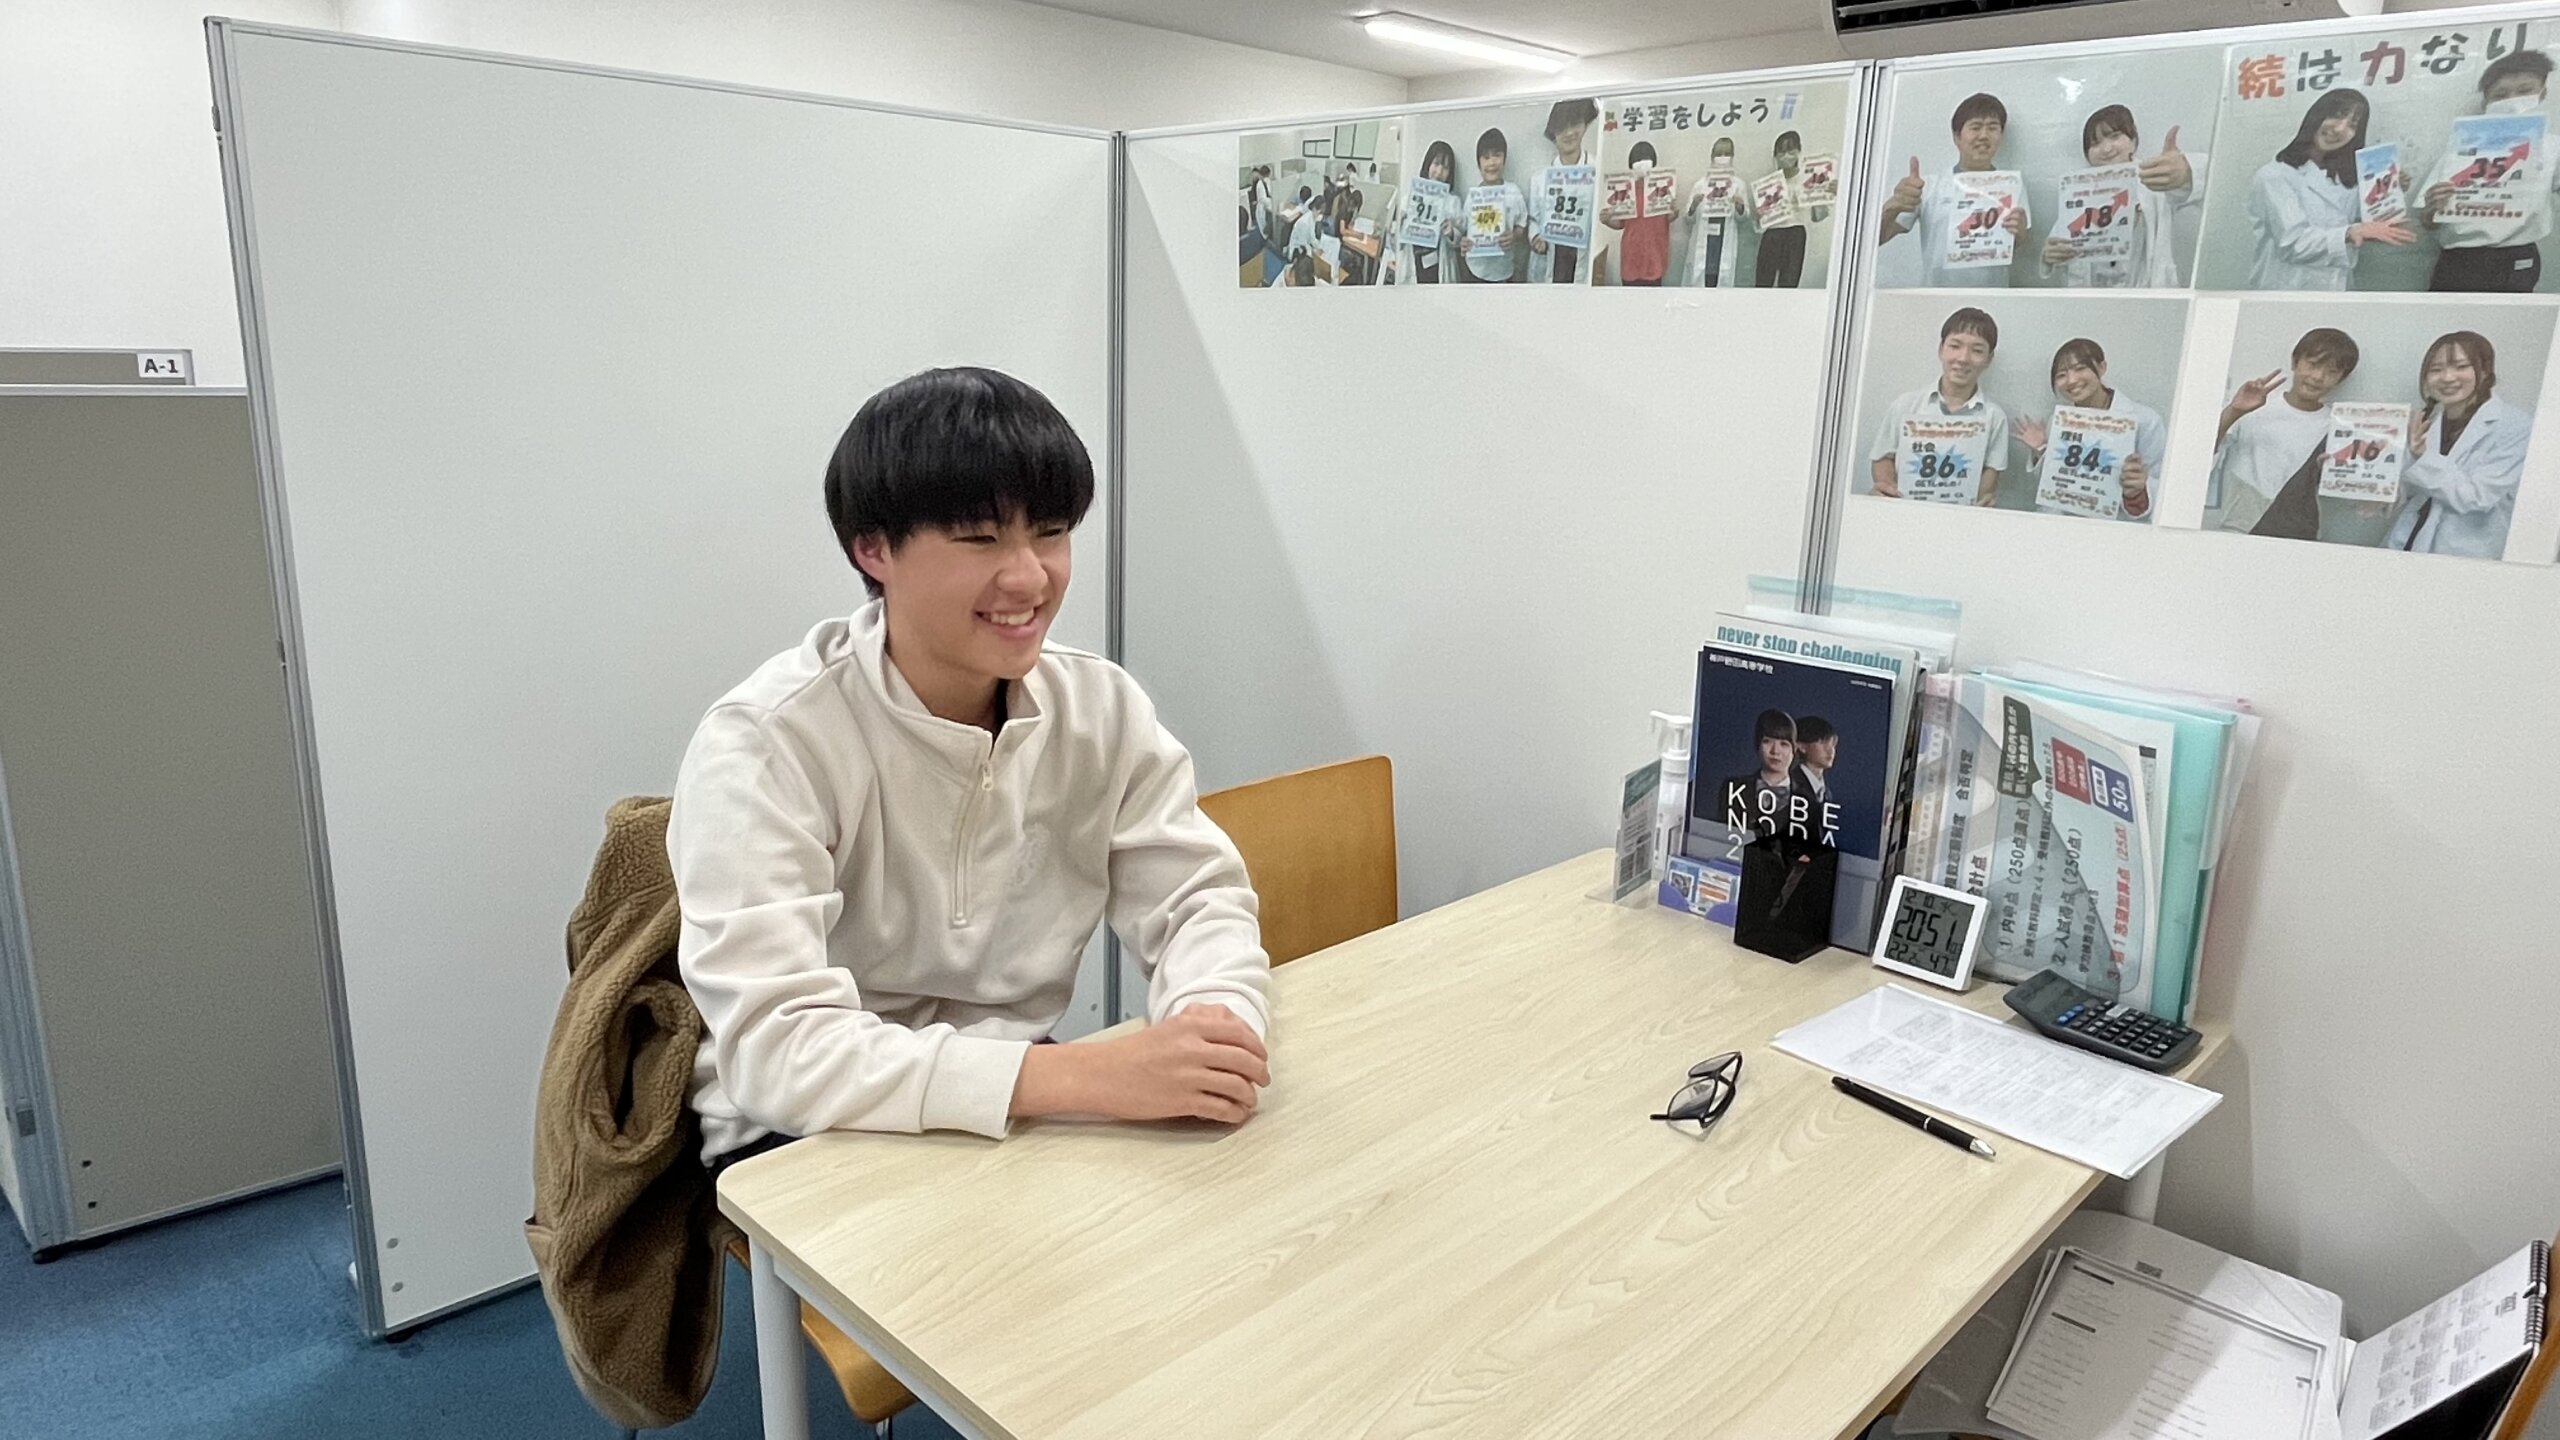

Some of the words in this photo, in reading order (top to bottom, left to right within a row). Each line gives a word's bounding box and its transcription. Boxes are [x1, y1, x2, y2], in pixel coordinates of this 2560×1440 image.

[1622, 98, 1770, 132] 学習をしよう
[143, 358, 179, 374] A-1
[1912, 441, 1936, 453] 社会
[2061, 430, 2084, 443] 理科
[1717, 625, 1761, 647] never
[1762, 634, 1798, 654] stop
[1800, 640, 1902, 673] challenging
[1955, 748, 1975, 801] 合否判定
[1727, 781, 1842, 831] KOBE
